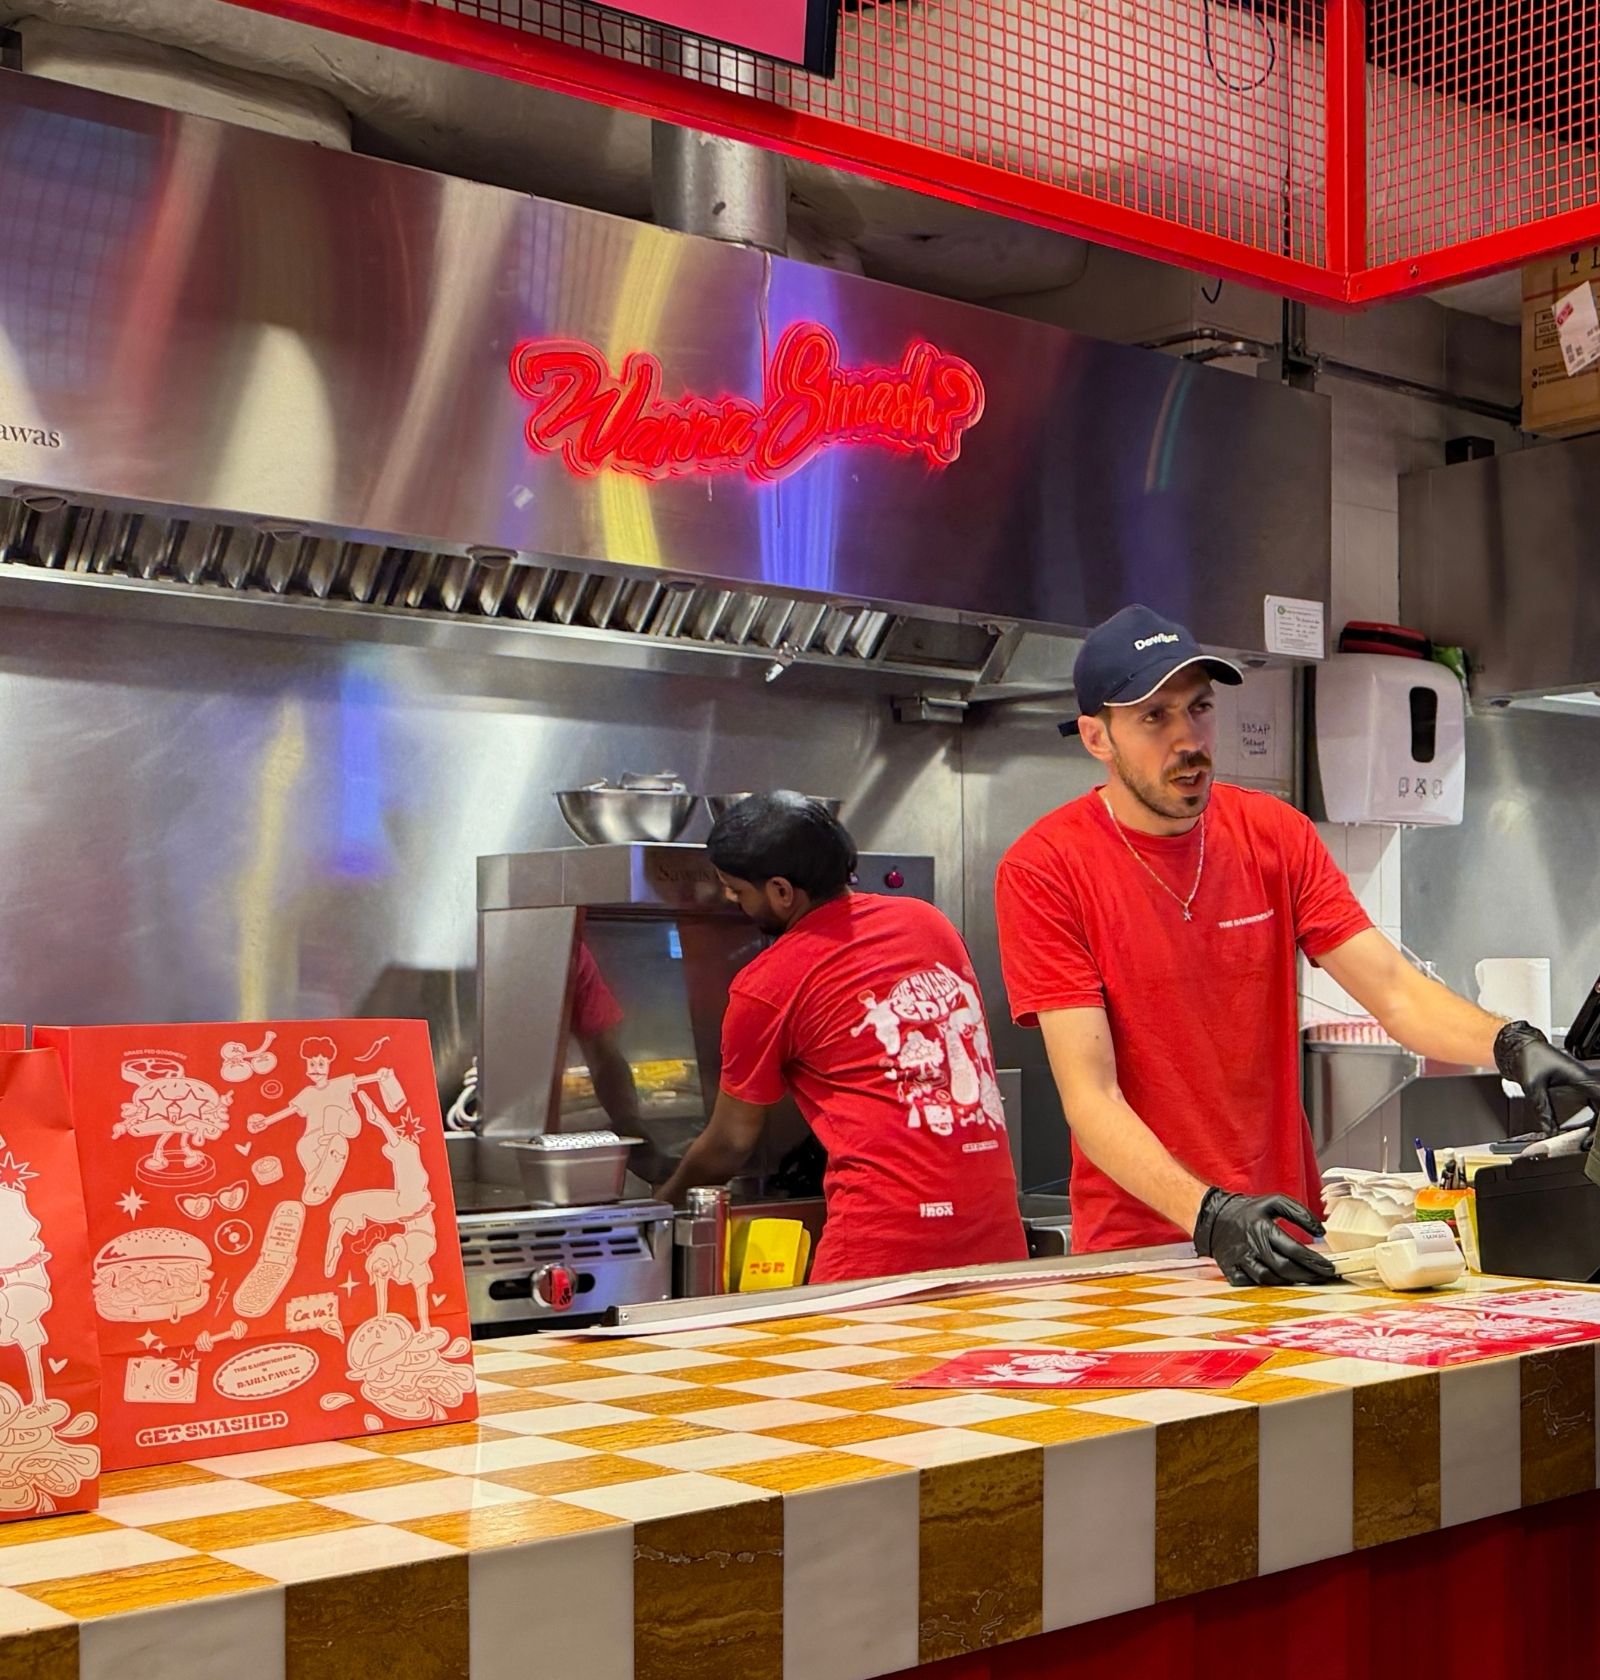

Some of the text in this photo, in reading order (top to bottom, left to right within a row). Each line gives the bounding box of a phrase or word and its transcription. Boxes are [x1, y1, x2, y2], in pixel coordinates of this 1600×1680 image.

[522, 328, 982, 470] Wanna Smash?
[313, 1302, 335, 1318] va?
[138, 1412, 287, 1446] GET SMASHED
